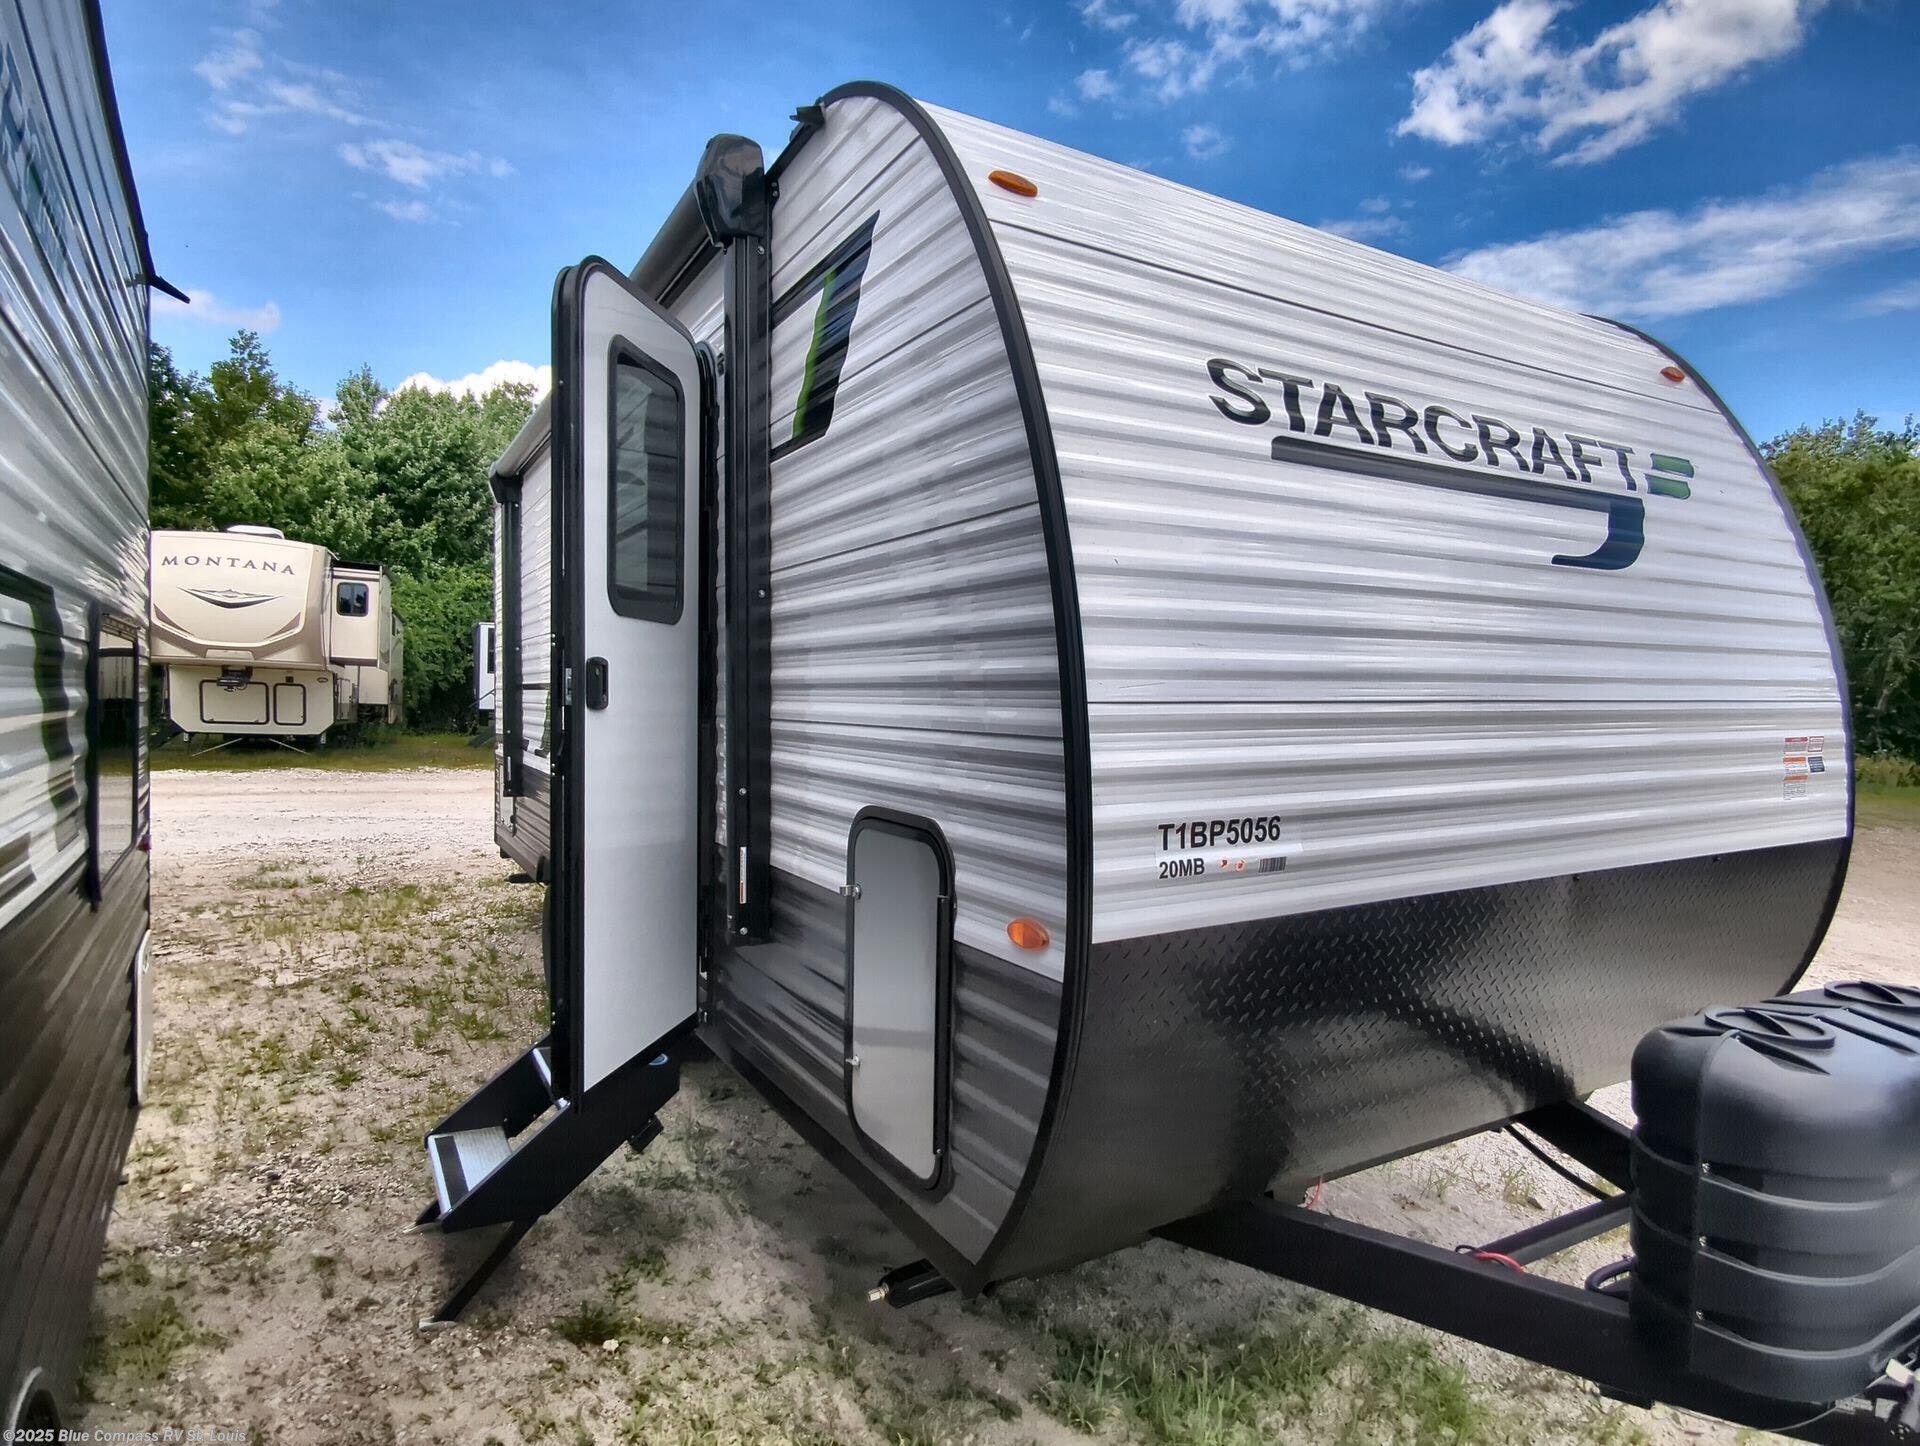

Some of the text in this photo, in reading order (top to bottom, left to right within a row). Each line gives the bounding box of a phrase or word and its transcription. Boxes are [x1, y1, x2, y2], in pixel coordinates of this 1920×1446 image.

[1206, 358, 1636, 492] STARCRAFT
[161, 555, 295, 575] MONTANA
[1158, 816, 1281, 850] T1BP5056
[1159, 858, 1205, 879] 20MB
